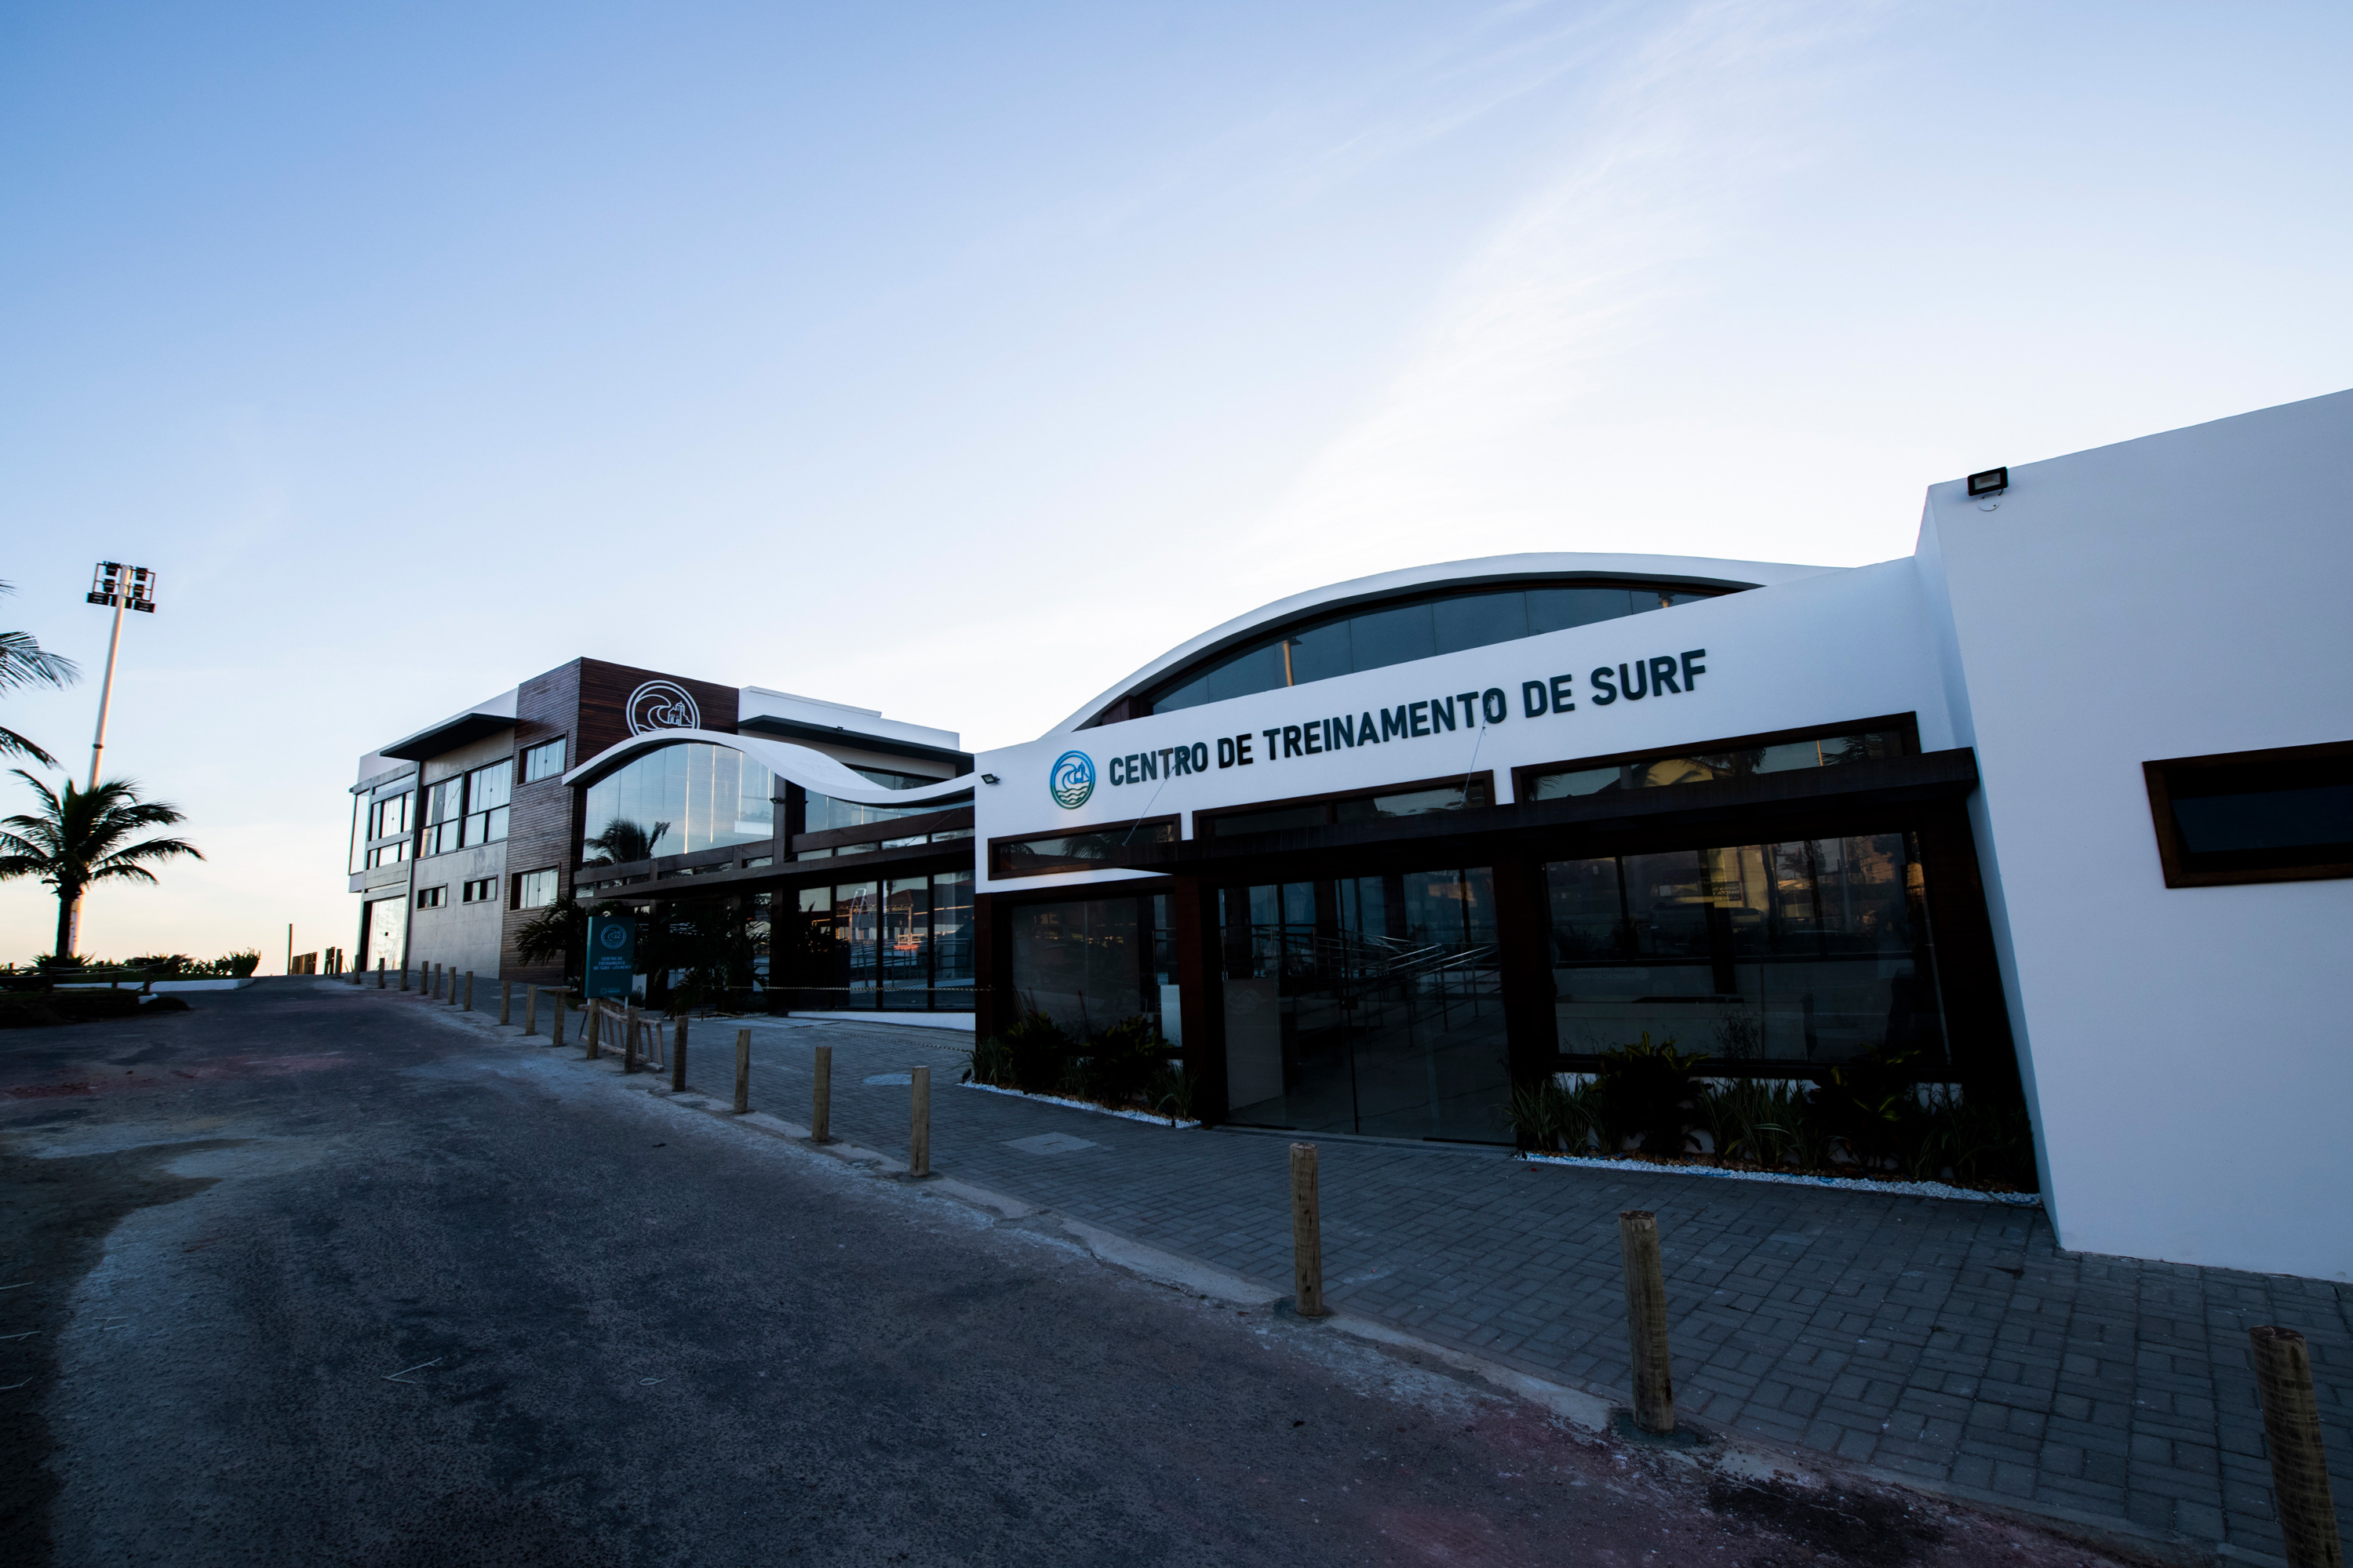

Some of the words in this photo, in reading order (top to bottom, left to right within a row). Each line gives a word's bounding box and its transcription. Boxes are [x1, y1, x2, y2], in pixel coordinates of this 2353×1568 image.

[1109, 742, 1208, 786] CENTRO
[1217, 733, 1254, 769] DE
[1262, 687, 1507, 761] TREINAMENTO
[1522, 674, 1575, 719] DE
[1590, 648, 1706, 706] SURF
